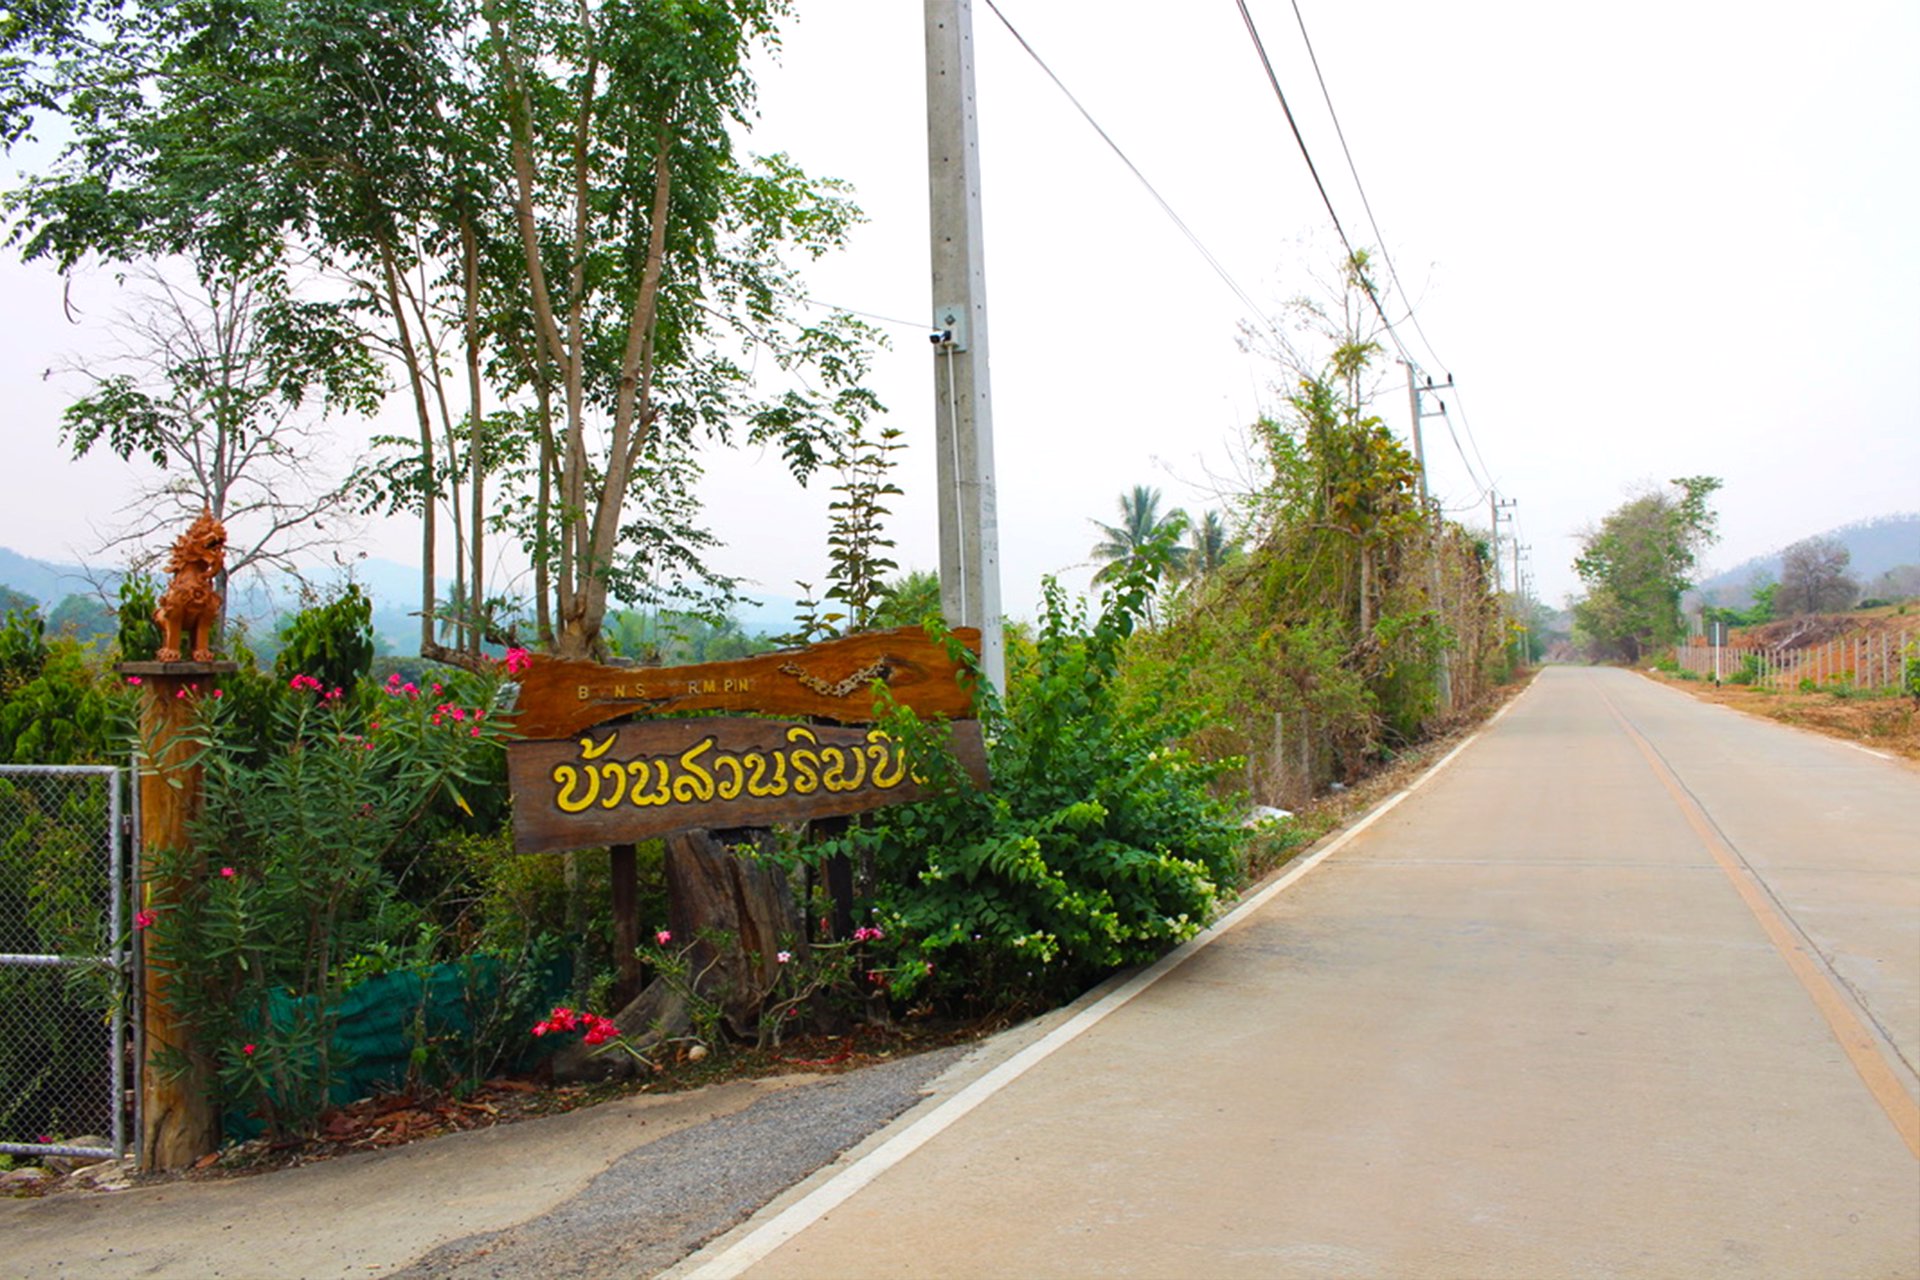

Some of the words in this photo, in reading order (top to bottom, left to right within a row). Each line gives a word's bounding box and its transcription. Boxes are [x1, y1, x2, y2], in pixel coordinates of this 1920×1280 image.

[553, 727, 929, 813] บ้านสวนริมปิ
